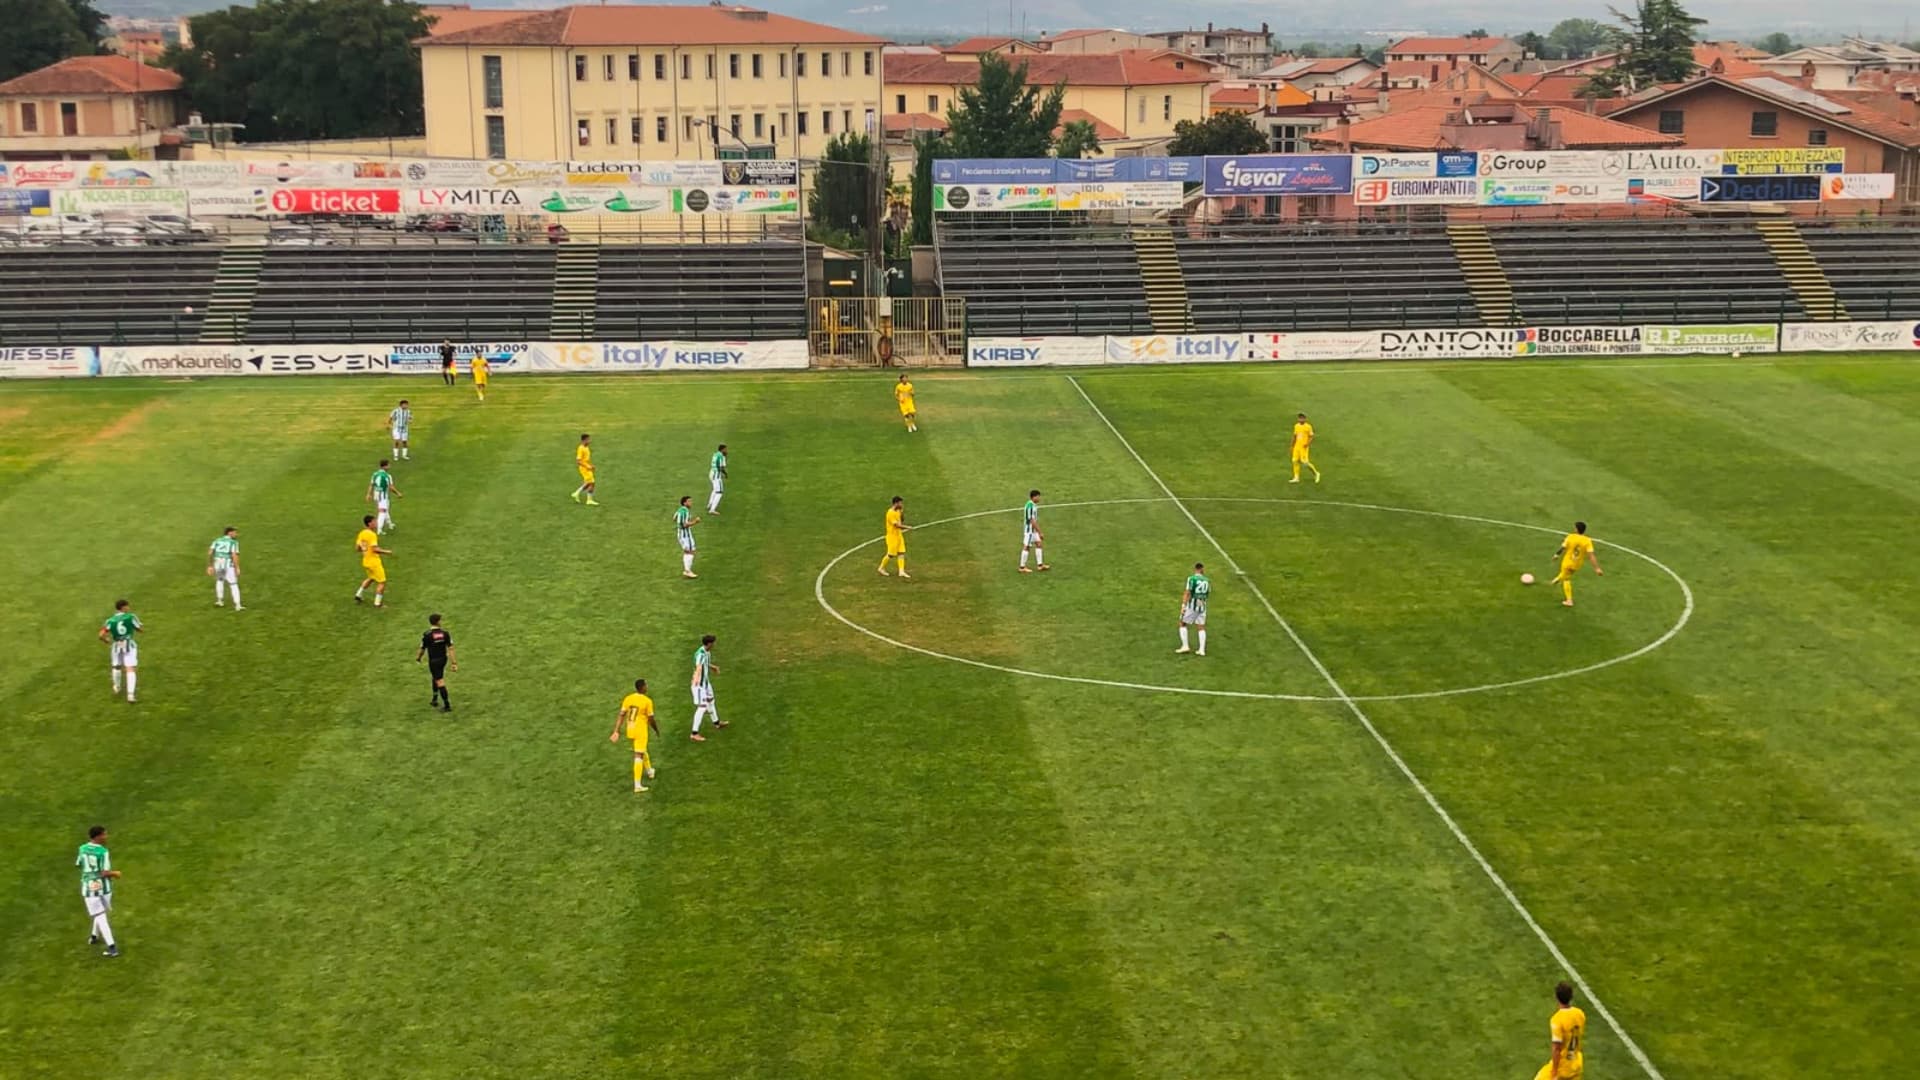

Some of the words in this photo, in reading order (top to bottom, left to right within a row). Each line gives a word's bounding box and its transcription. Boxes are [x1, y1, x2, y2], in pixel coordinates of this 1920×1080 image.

[1493, 155, 1546, 173] Group
[1391, 180, 1466, 195] EUROIMPIANTI
[1555, 184, 1599, 196] POLI
[1721, 178, 1819, 199] Dedalus
[311, 191, 381, 212] ticket
[419, 189, 521, 205] LYMITA
[1381, 331, 1513, 351] DANTONI
[1539, 328, 1641, 342] BOCCABELLA
[0, 348, 75, 360] IESSE
[495, 344, 528, 353] 2009
[973, 348, 1041, 361] KIRBY
[1175, 336, 1239, 360] italy
[142, 353, 242, 369] markaurelio
[555, 345, 595, 364] TC
[603, 344, 668, 368] italy
[675, 351, 744, 364] KIRBY
[1195, 580, 1209, 594] 20
[116, 620, 127, 635] 6
